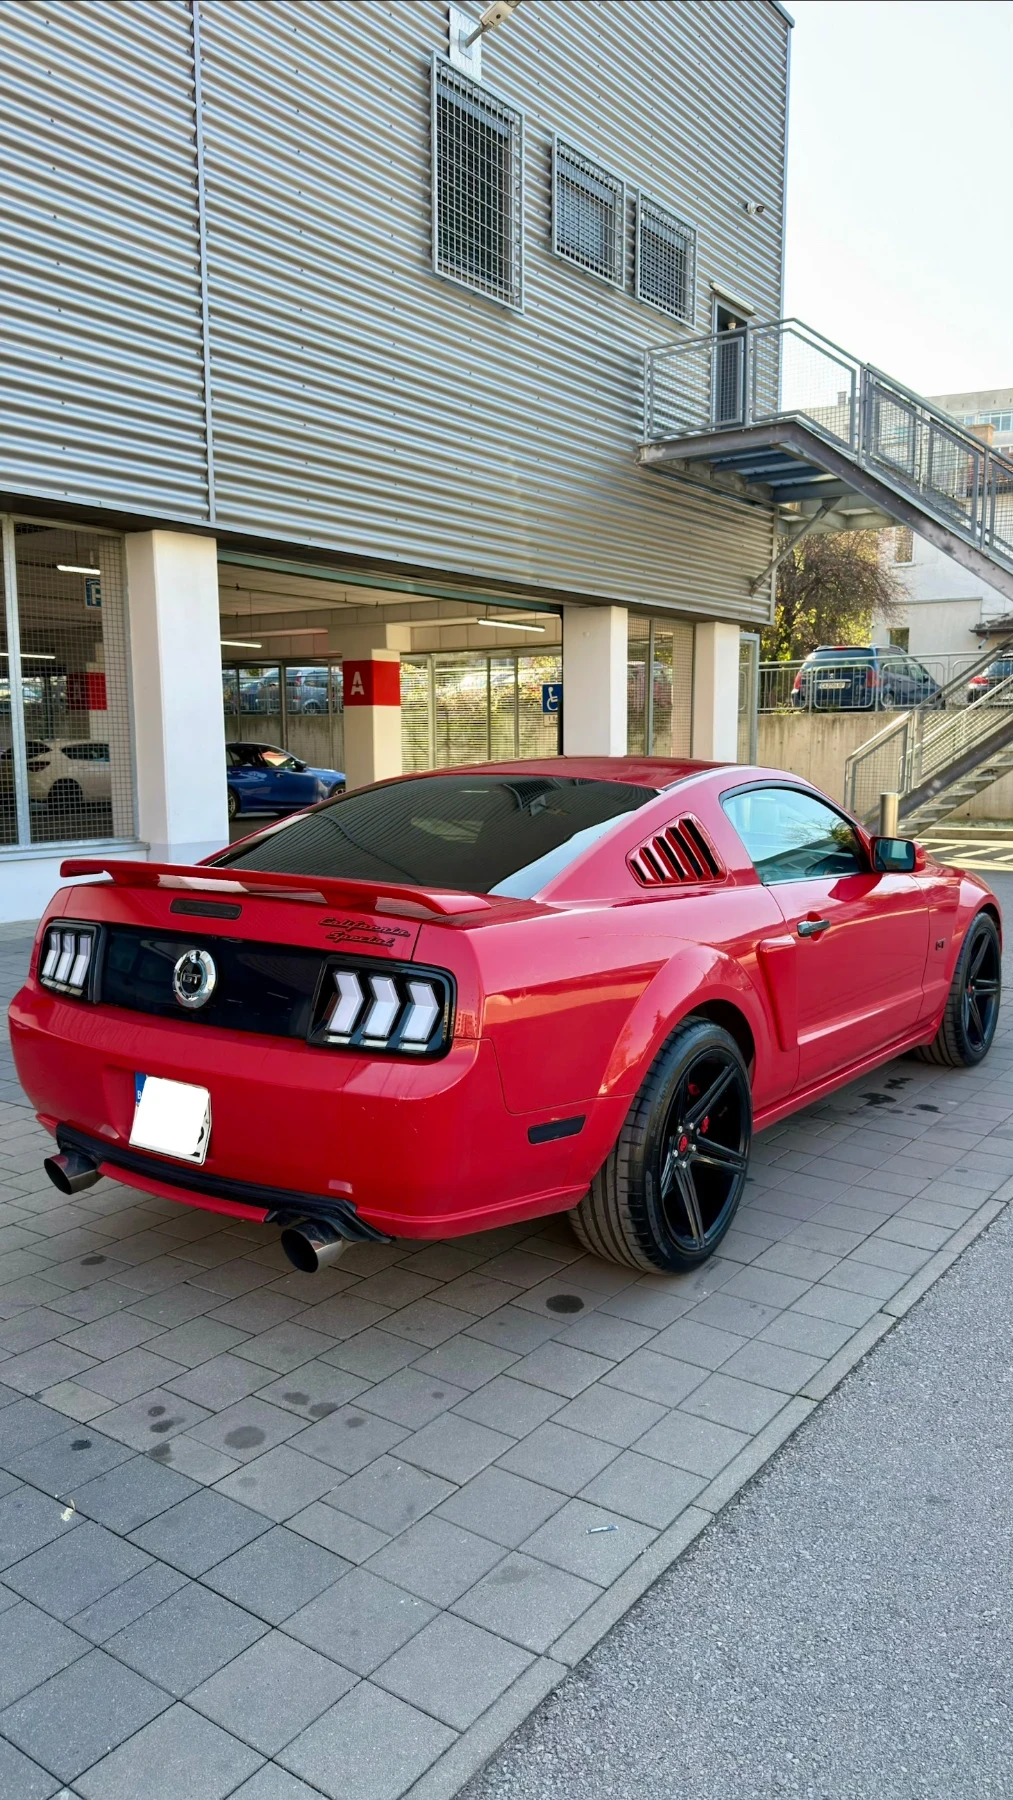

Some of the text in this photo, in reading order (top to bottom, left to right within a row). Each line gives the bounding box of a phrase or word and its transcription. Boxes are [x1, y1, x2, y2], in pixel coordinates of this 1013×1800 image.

[350, 671, 365, 696] A
[318, 917, 411, 938] California
[325, 931, 395, 947] Special
[183, 972, 201, 985] GT
